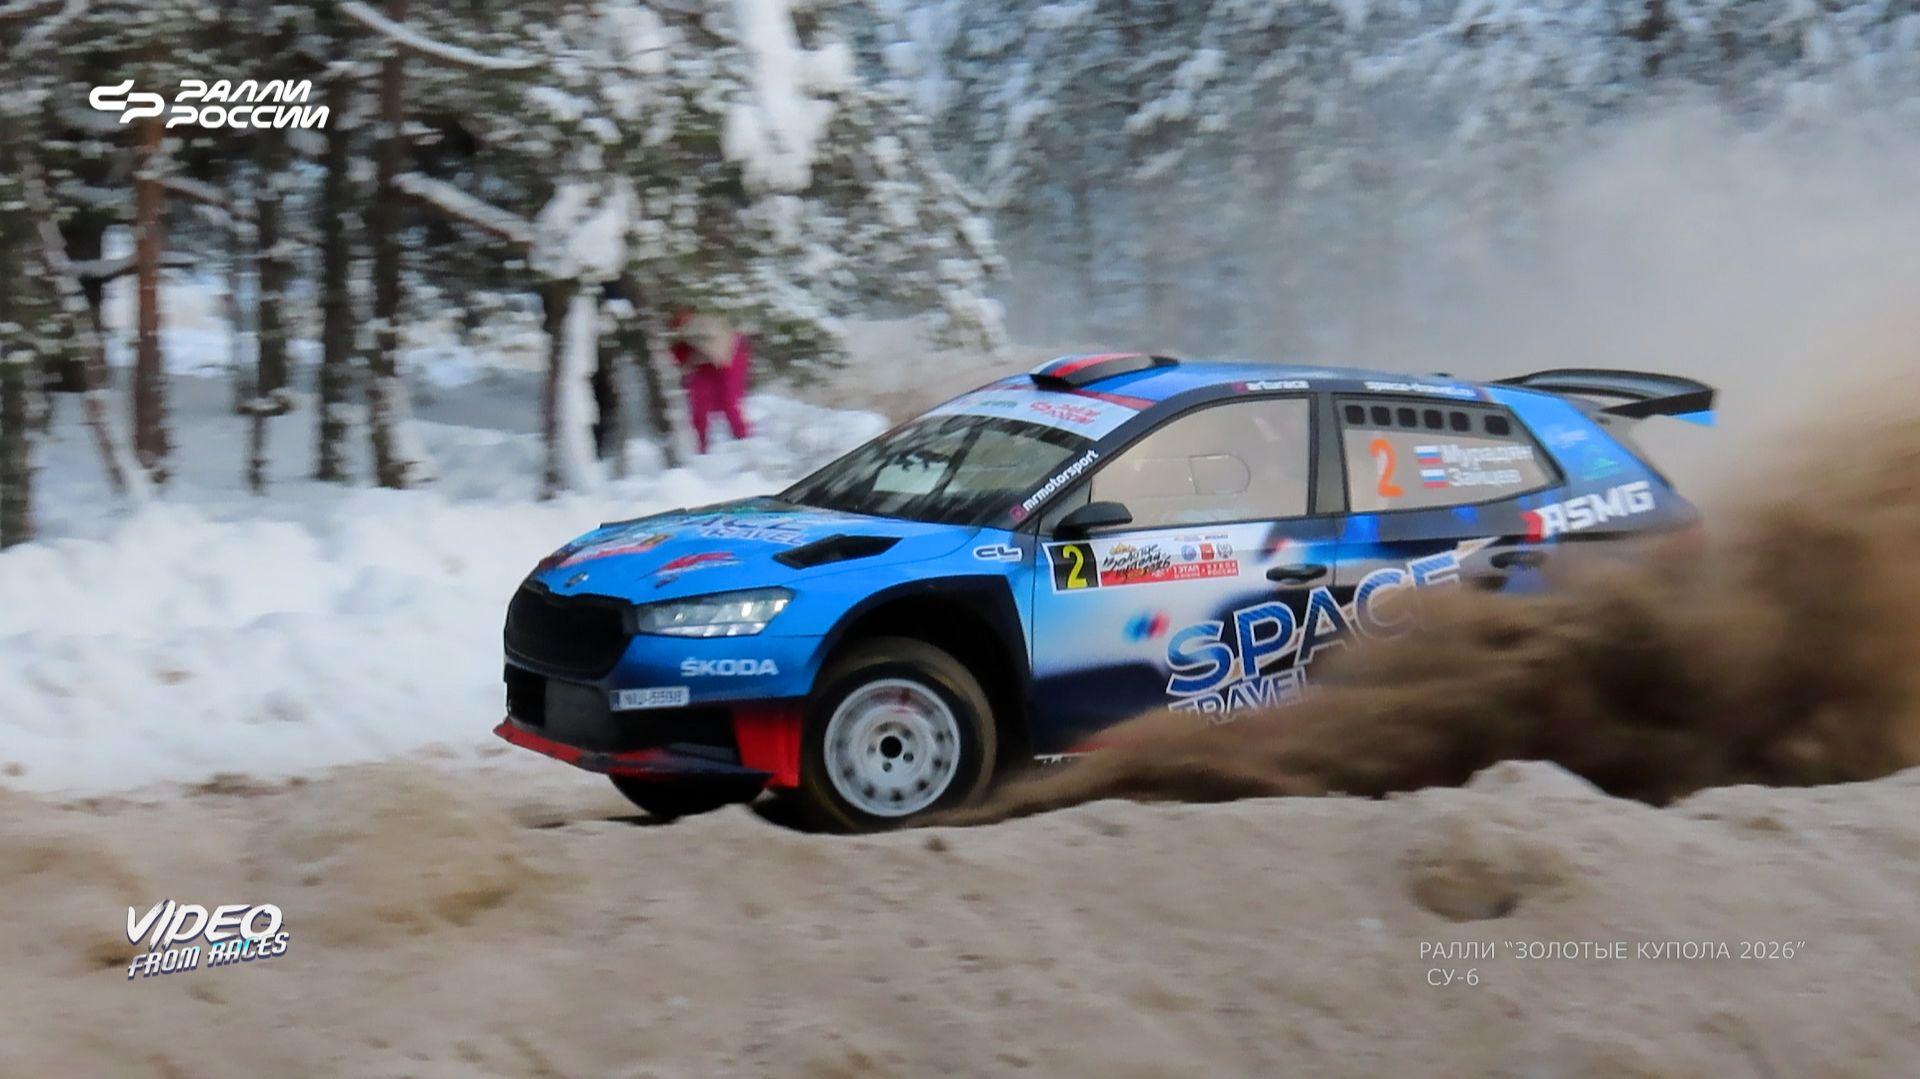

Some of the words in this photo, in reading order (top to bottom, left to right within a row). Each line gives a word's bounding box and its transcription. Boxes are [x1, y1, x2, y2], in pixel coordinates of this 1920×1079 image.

[1022, 449, 1099, 513] mrmotorsport
[1368, 438, 1404, 497] 2
[1528, 481, 1656, 538] ASMG
[1062, 543, 1088, 589] 2
[680, 656, 779, 676] ŠKODA
